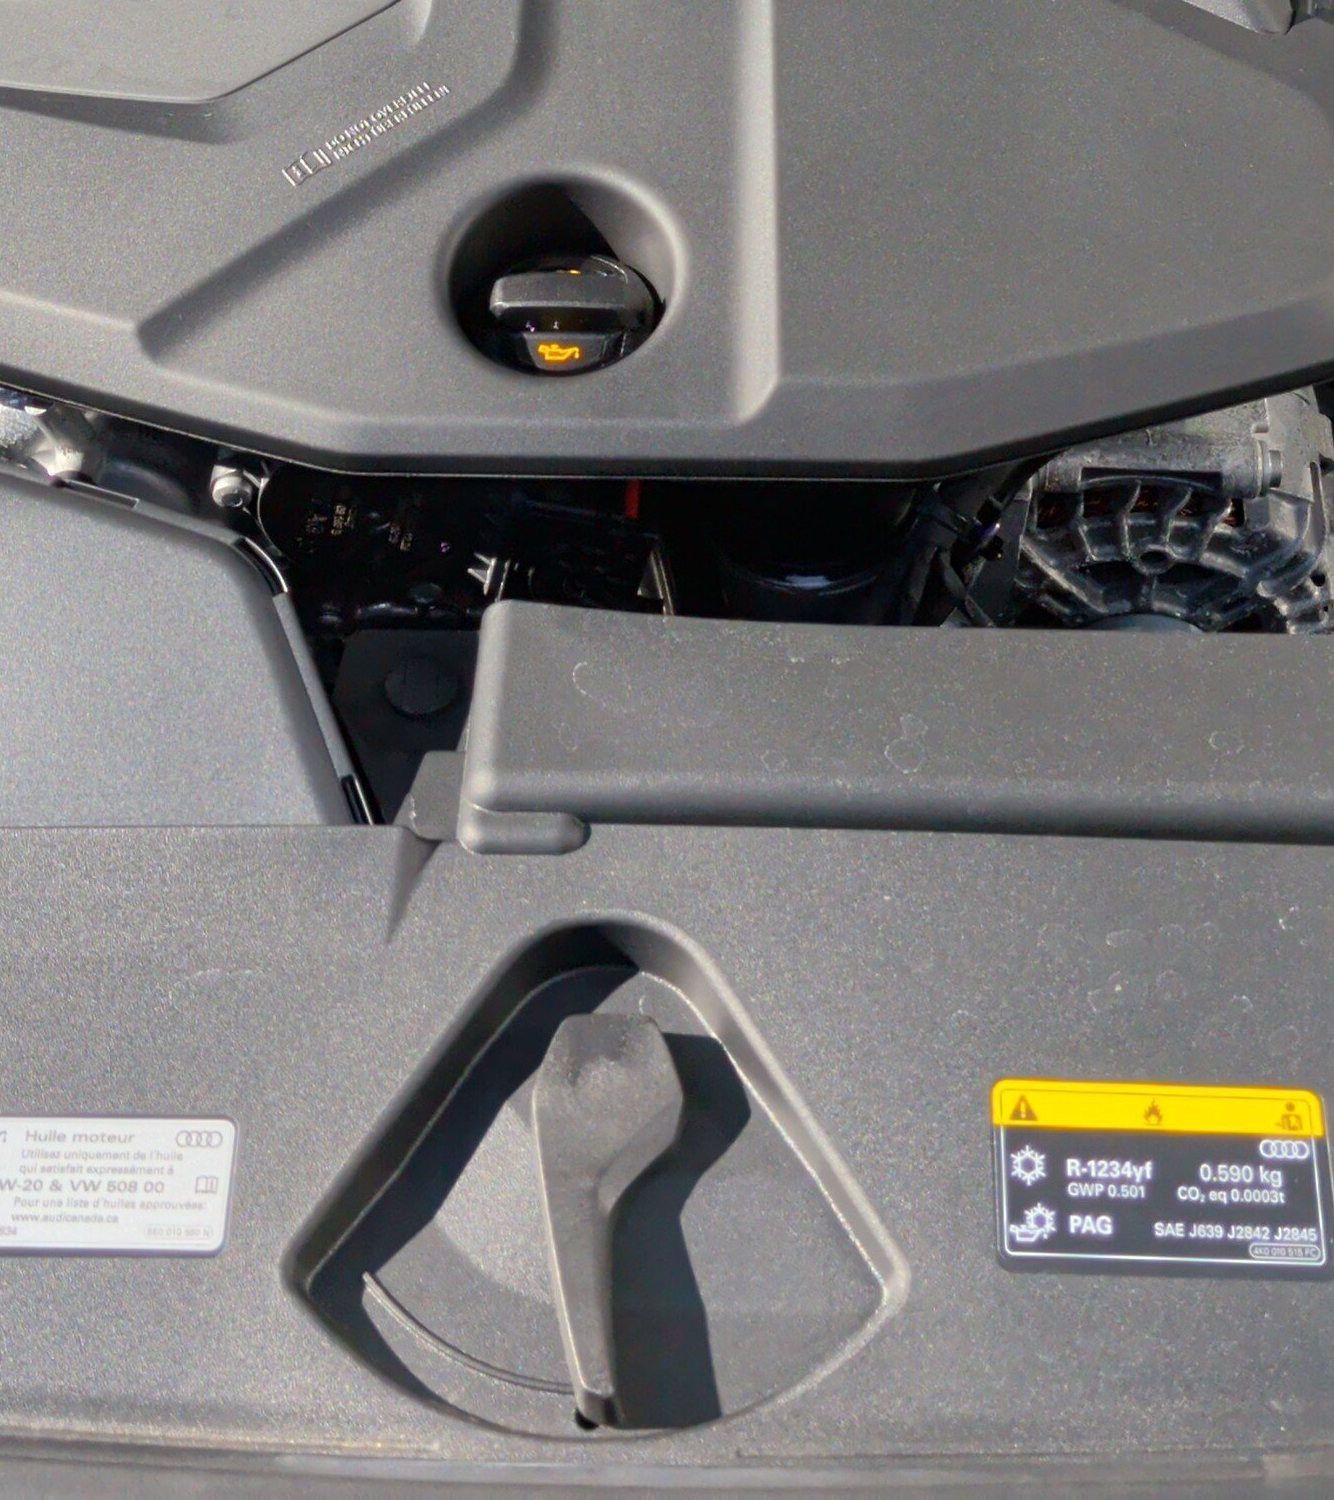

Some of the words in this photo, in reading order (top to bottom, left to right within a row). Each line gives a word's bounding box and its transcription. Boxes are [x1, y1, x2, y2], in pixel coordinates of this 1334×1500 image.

[25, 1130, 66, 1143] Huile
[72, 1132, 135, 1144] moteur
[21, 1149, 60, 1160] Utilisez
[64, 1150, 129, 1162] uniquement
[133, 1150, 146, 1160] de
[19, 1163, 37, 1175] qui
[40, 1164, 83, 1174] satisfait
[86, 1165, 164, 1176] expressément
[1066, 1158, 1153, 1181] R-1234yf
[1199, 1163, 1253, 1183] 0.590
[1259, 1164, 1283, 1188] kg
[49, 1180, 63, 1191] &
[71, 1180, 102, 1192] VW
[107, 1181, 138, 1192] 508
[143, 1181, 165, 1193] 00
[1067, 1183, 1104, 1198] GWP
[1108, 1184, 1146, 1199] 0.501
[13, 1196, 39, 1208] Pour
[42, 1199, 63, 1208] une
[67, 1198, 89, 1208] liste
[139, 1200, 207, 1211] approuvées:
[1209, 1190, 1227, 1204] eq
[1231, 1189, 1285, 1204] 0.0003t
[11, 1212, 119, 1223] www.audicanada.ca
[1069, 1214, 1113, 1235] PAG
[1154, 1222, 1185, 1237] SAE
[1189, 1224, 1223, 1238] J639
[1228, 1225, 1270, 1240] J2842
[1274, 1227, 1317, 1242] J2845
